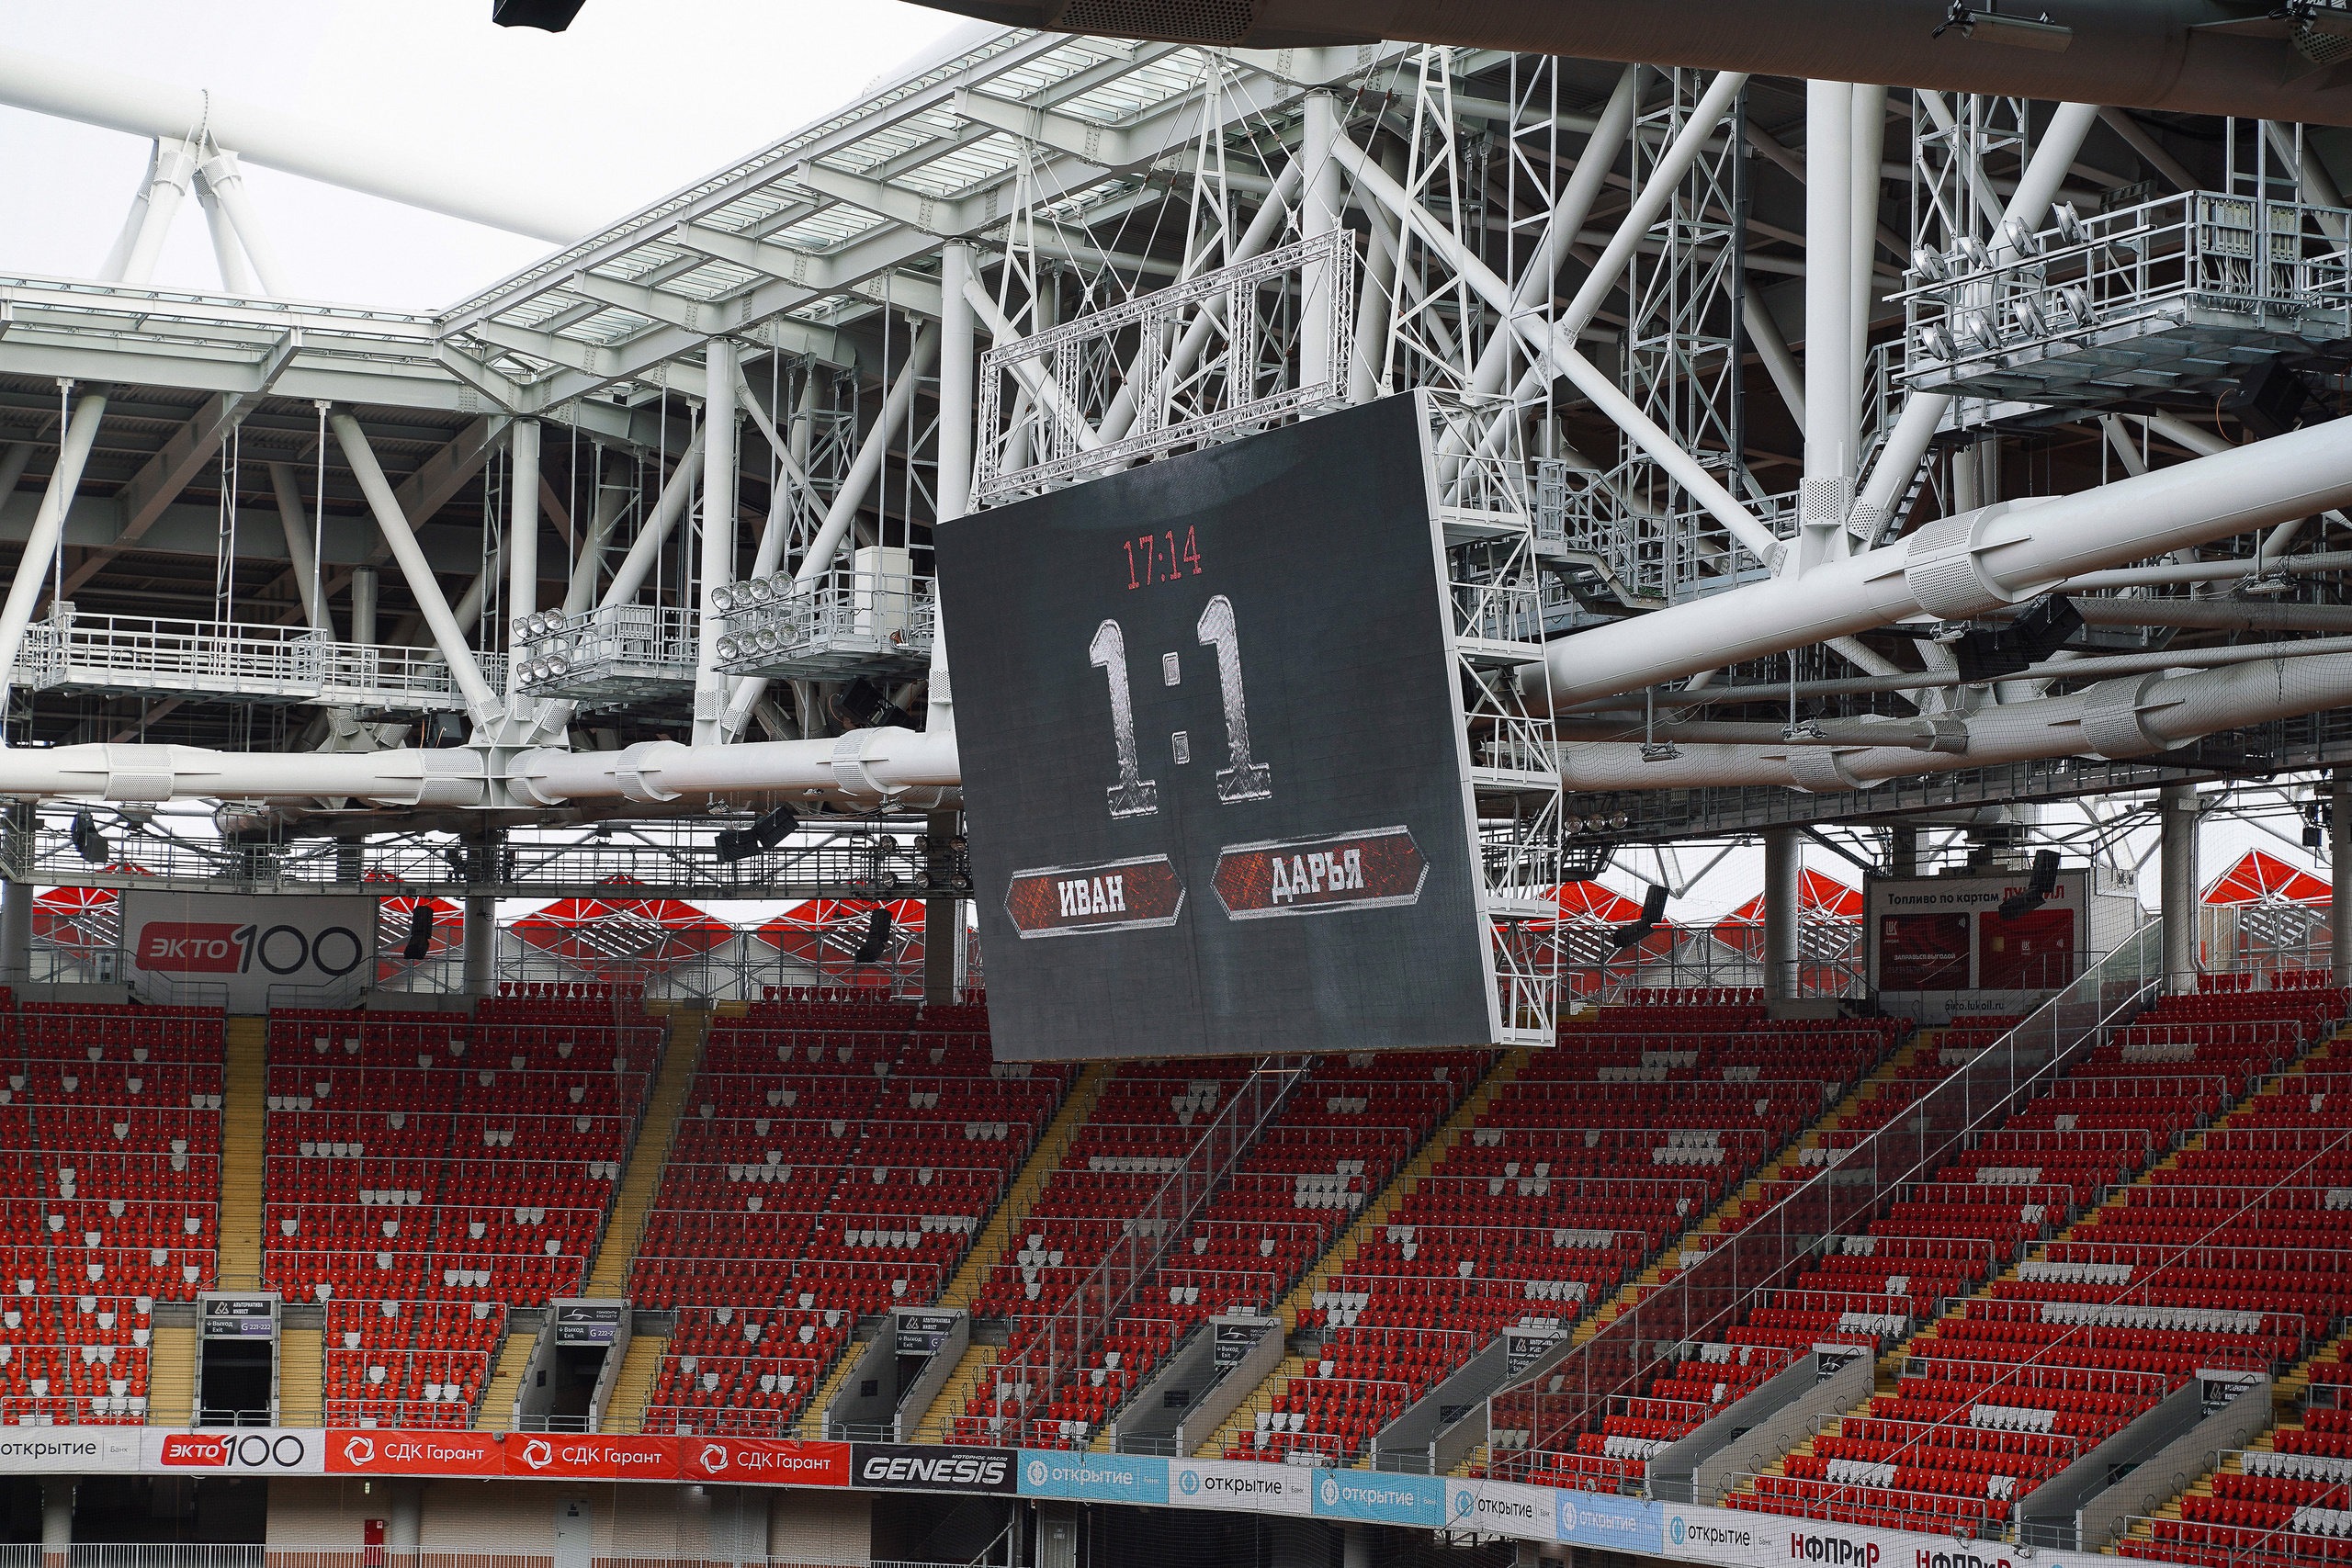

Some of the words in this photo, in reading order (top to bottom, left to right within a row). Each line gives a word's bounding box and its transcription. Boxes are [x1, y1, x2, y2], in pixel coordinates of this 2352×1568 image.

[1123, 525, 1203, 590] 17:14
[1271, 849, 1365, 903] ДАРЬЯ
[1057, 875, 1126, 918] ИВАН
[1888, 894, 1937, 905] Топливо
[1940, 896, 1953, 904] по
[1957, 893, 1999, 906] картам
[149, 938, 229, 958] ЭКТО
[234, 924, 363, 976] 100
[241, 1323, 248, 1331] G
[590, 1328, 597, 1337] G
[1, 1441, 96, 1459] открытие
[110, 1445, 129, 1453] Банк
[168, 1444, 220, 1459] ЭКТО
[222, 1434, 305, 1467] 100
[384, 1443, 423, 1462] СДК
[427, 1444, 485, 1461] Гарант
[561, 1447, 600, 1465] СДК
[605, 1448, 662, 1466] Гарант
[737, 1451, 773, 1471] СДК
[776, 1453, 831, 1472] Гарант
[863, 1457, 1008, 1484] GENESIS
[1052, 1467, 1133, 1486] открытие
[1204, 1476, 1282, 1495] открытие
[1342, 1487, 1414, 1506] открытие
[1477, 1497, 1532, 1518] открытие
[1579, 1511, 1636, 1532] открытие
[1688, 1524, 1750, 1547] открытие
[1758, 1537, 1772, 1547] Банк
[1792, 1532, 1880, 1568] НФПРиР
